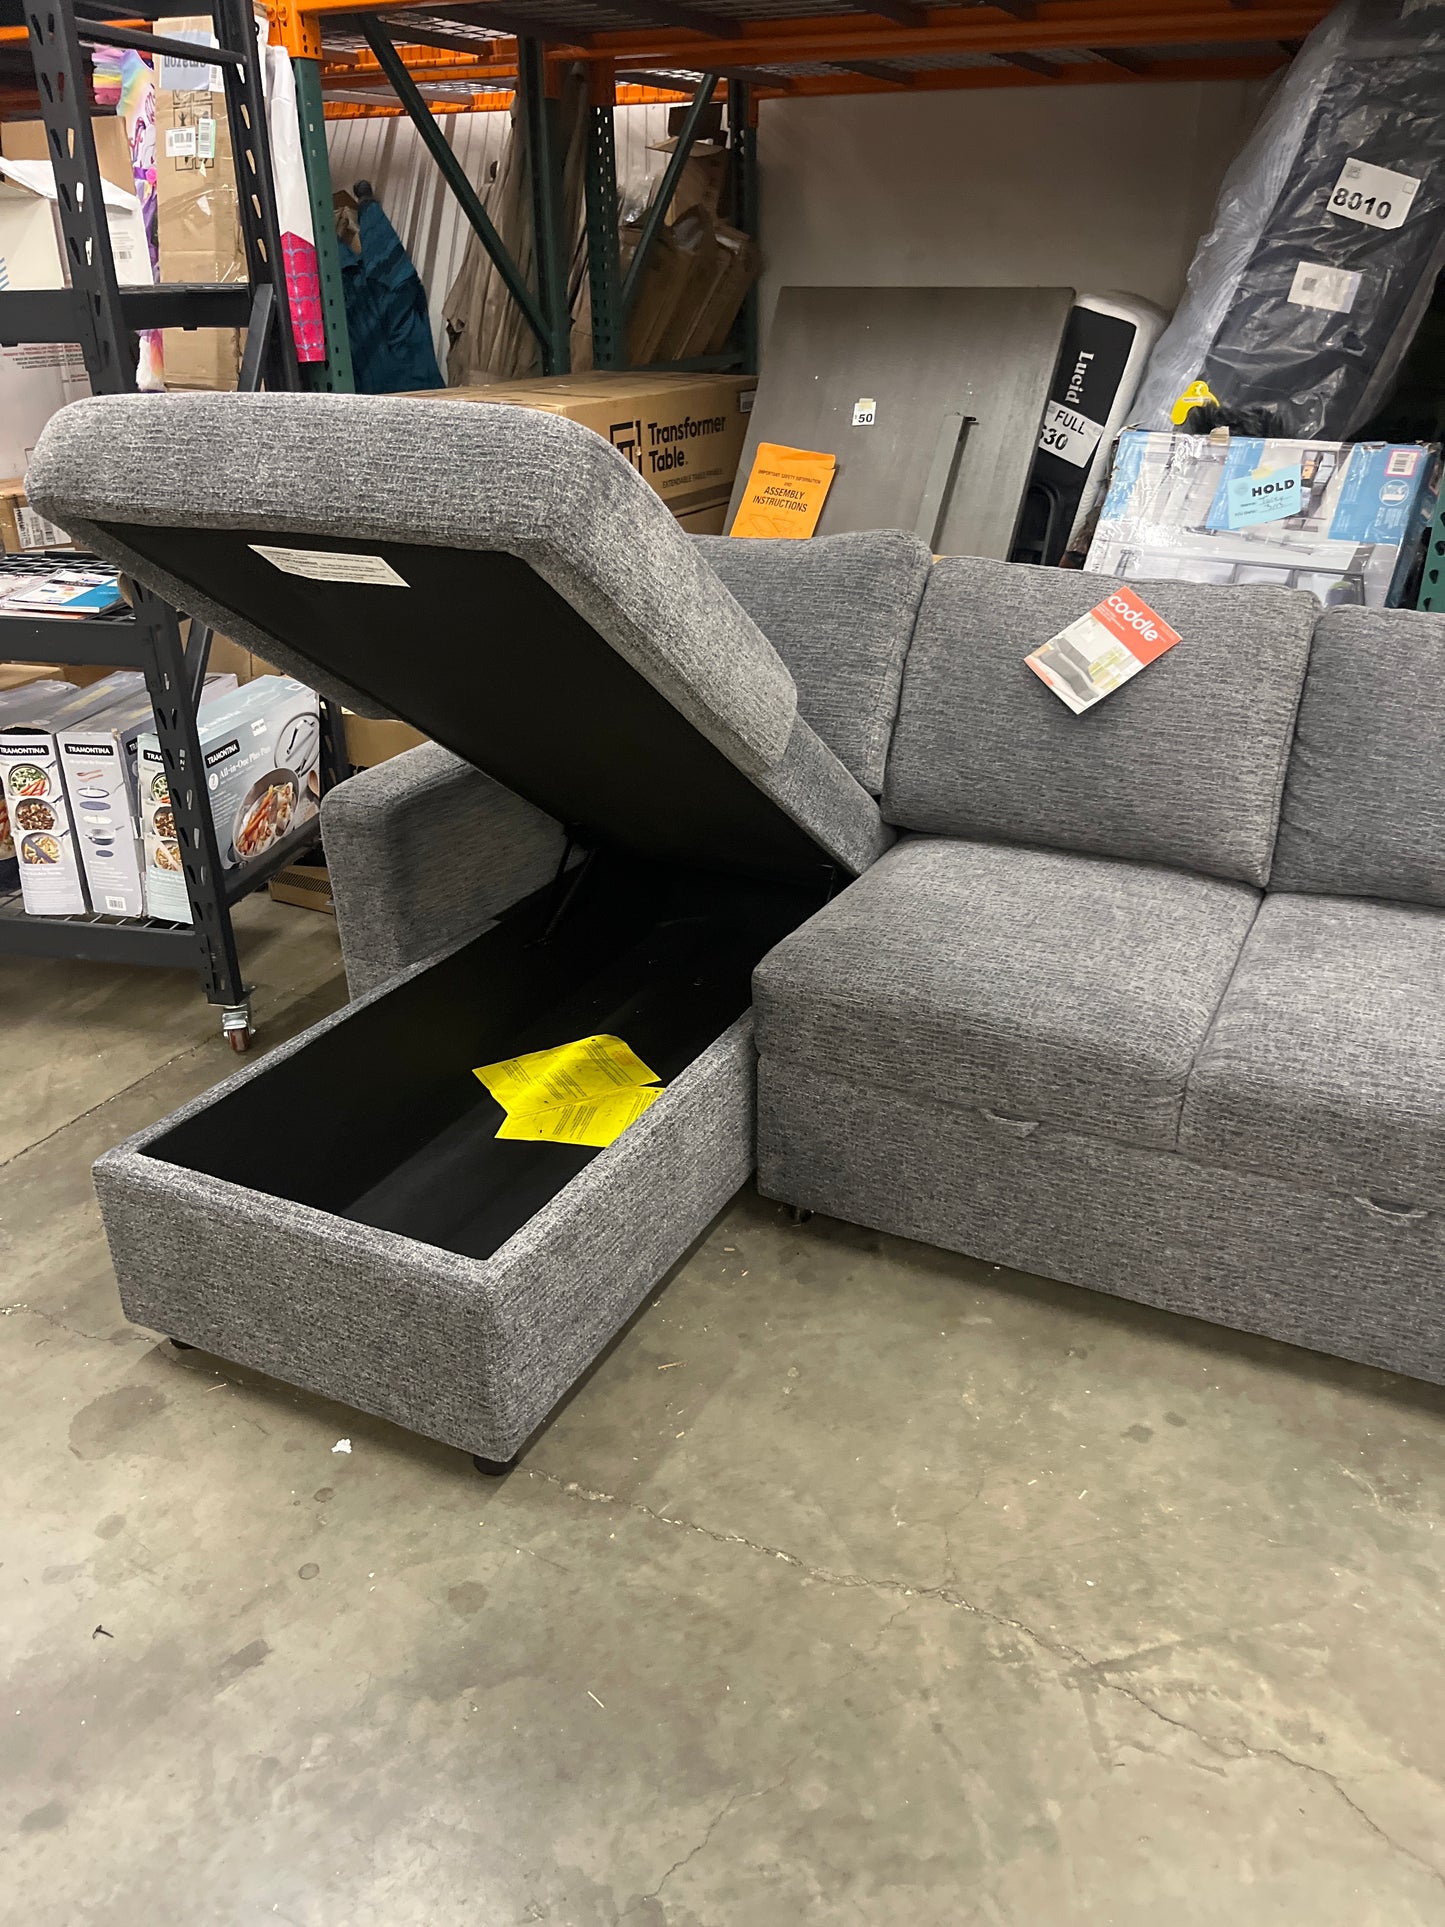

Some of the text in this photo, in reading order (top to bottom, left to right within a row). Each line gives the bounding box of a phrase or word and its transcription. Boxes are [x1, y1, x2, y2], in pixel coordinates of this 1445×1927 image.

[1333, 188, 1391, 219] 8010
[1065, 351, 1094, 404] Lucid
[647, 416, 726, 446] Transformer
[1054, 410, 1085, 435] FULL
[648, 446, 685, 473] Table
[764, 486, 805, 500] ASSEMBLY
[1251, 480, 1295, 497] HOLD
[753, 495, 808, 513] INSTRUCTIONS
[1107, 595, 1159, 642] coddle
[0, 747, 45, 755] TRAMONTINA
[67, 745, 110, 755] TRAMONTINA
[207, 743, 238, 765] TRAMONTINA
